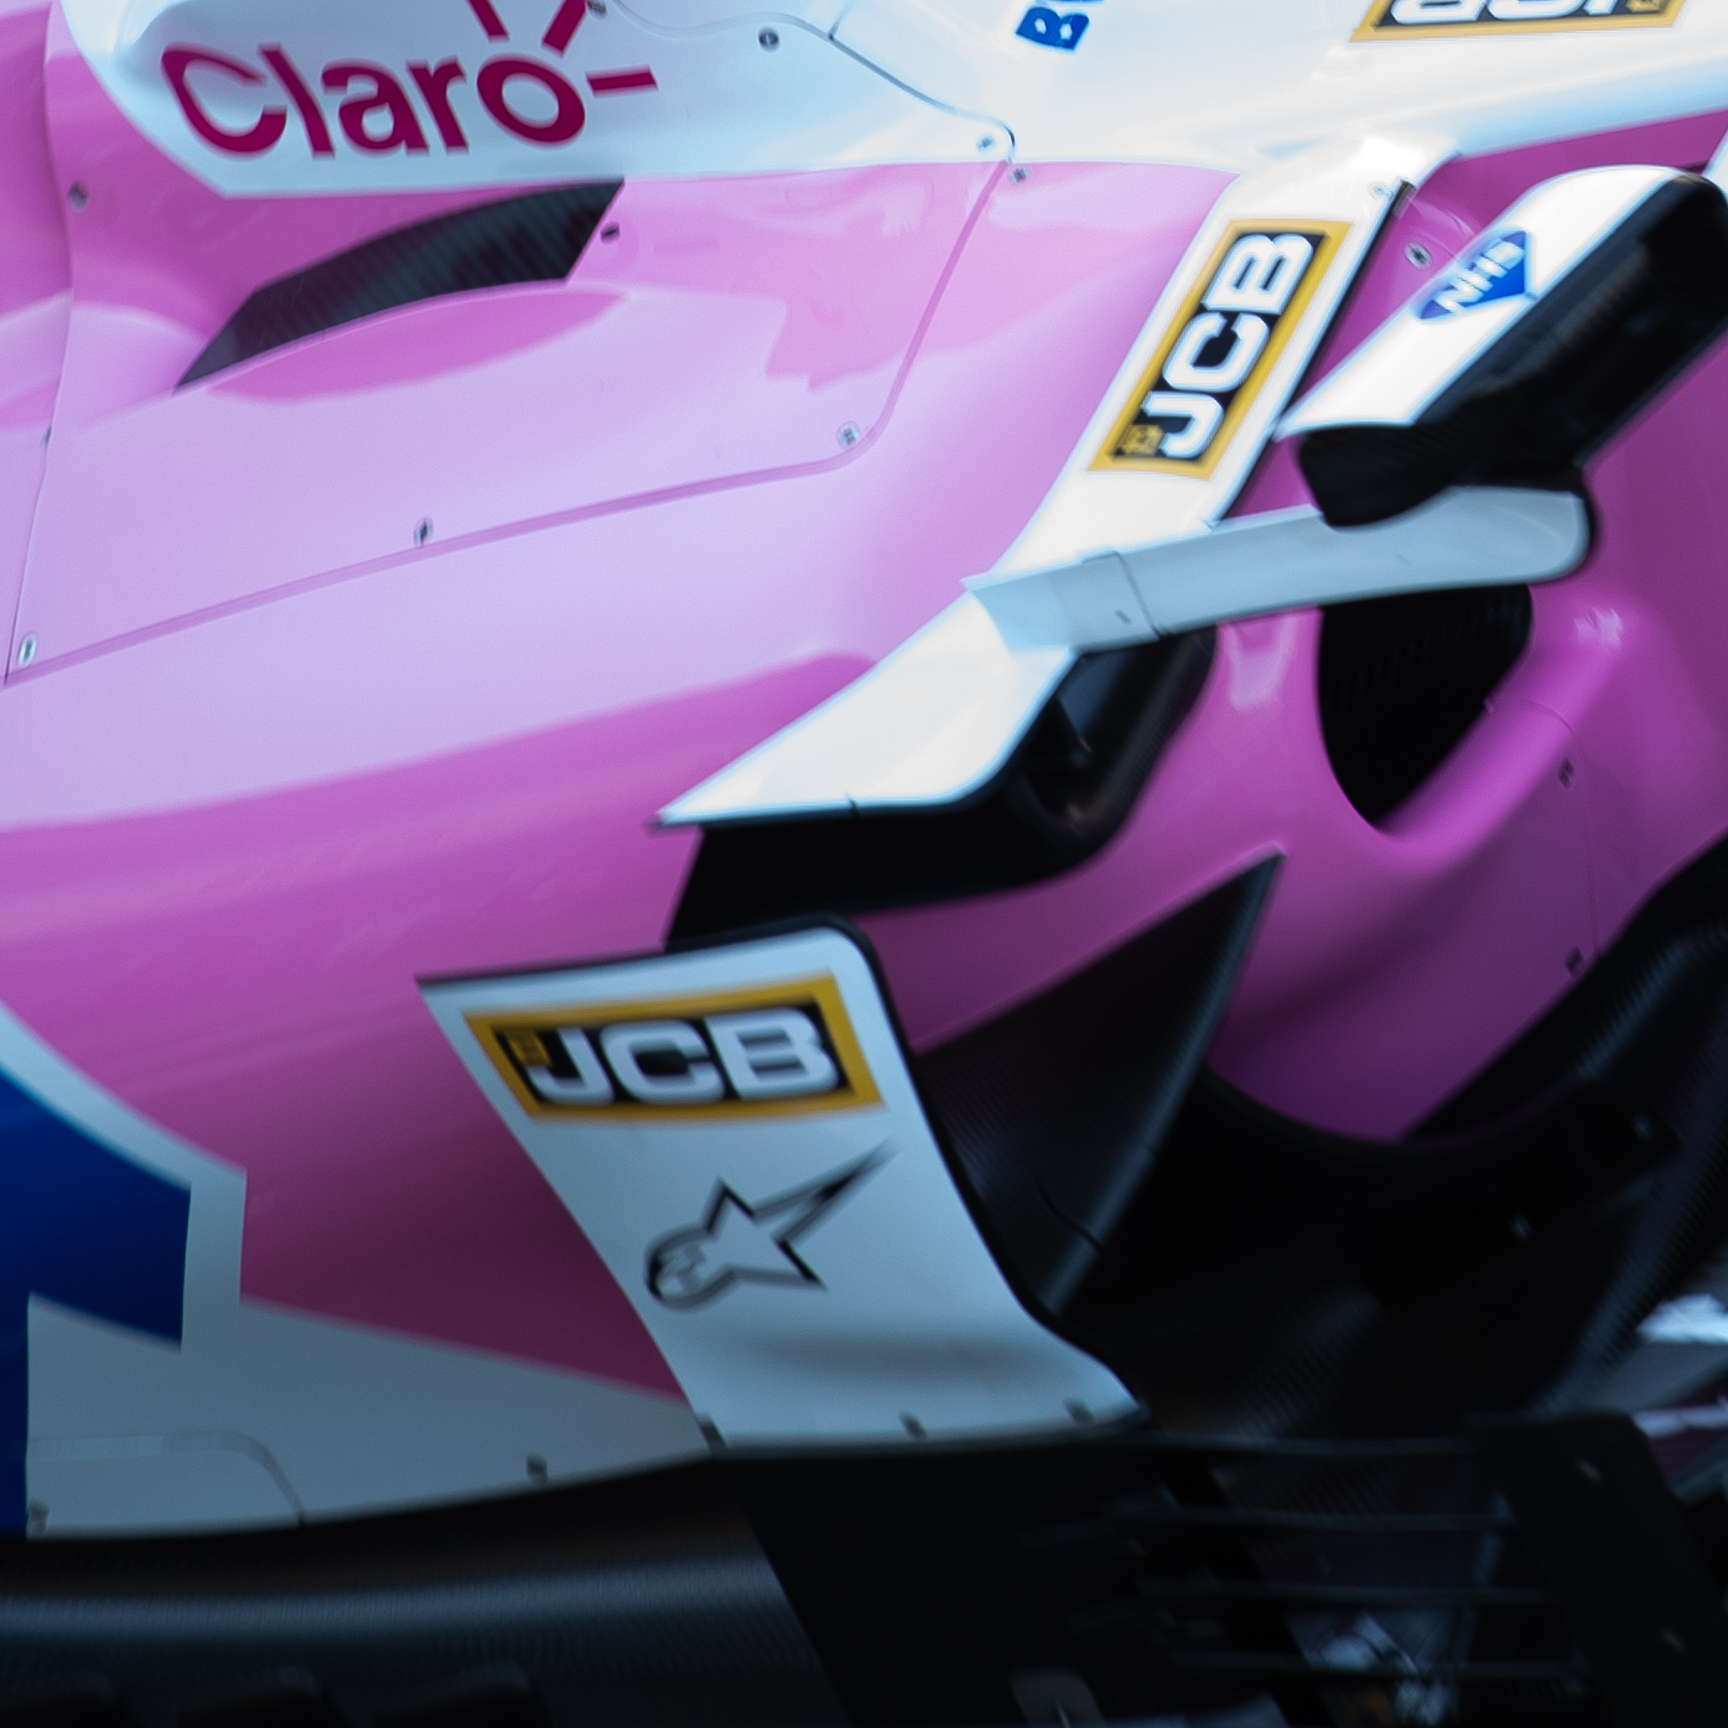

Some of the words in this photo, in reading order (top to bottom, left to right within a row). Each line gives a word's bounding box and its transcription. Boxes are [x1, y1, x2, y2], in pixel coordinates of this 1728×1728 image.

[161, 37, 587, 159] Claro
[1141, 234, 1314, 459] JCB
[525, 1007, 840, 1105] JCB
